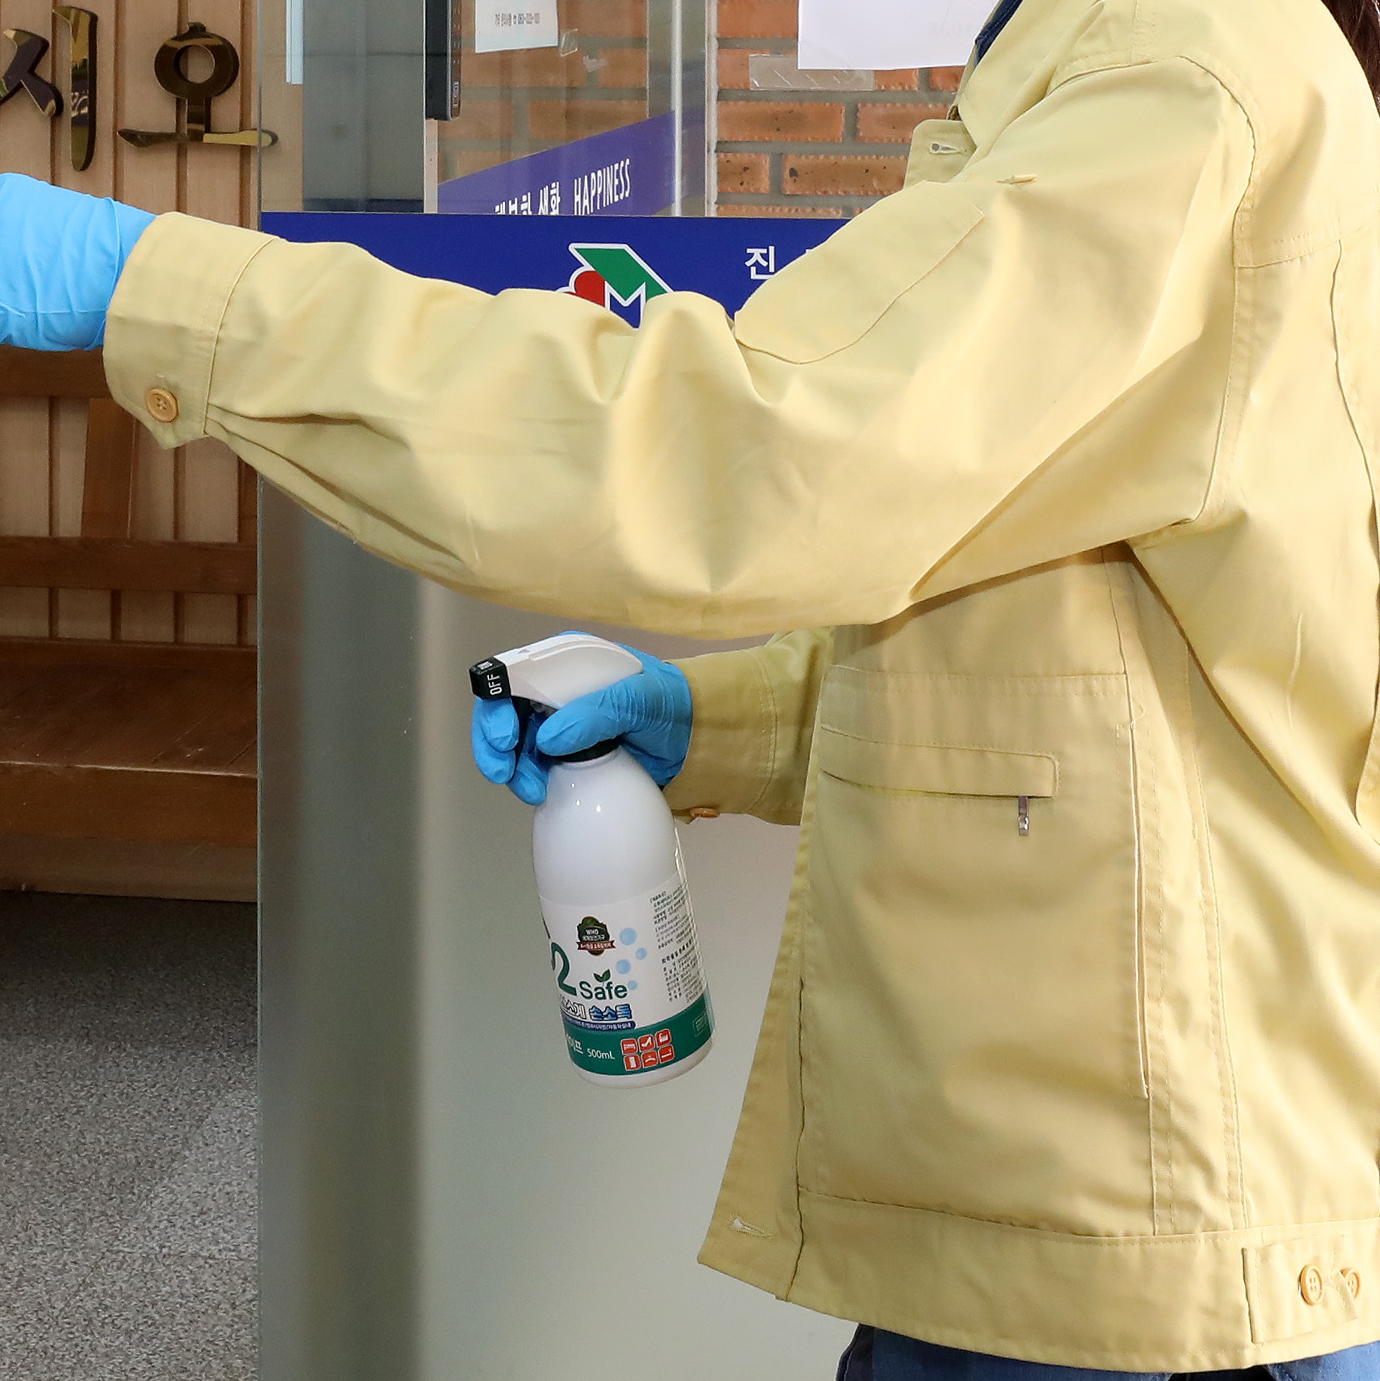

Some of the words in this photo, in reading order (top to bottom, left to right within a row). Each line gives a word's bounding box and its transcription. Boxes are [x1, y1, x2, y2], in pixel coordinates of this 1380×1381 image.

[574, 158, 631, 216] HAPPINESS
[487, 674, 503, 696] OFF
[579, 980, 629, 1000] Safe
[587, 1048, 615, 1060] 500mL
